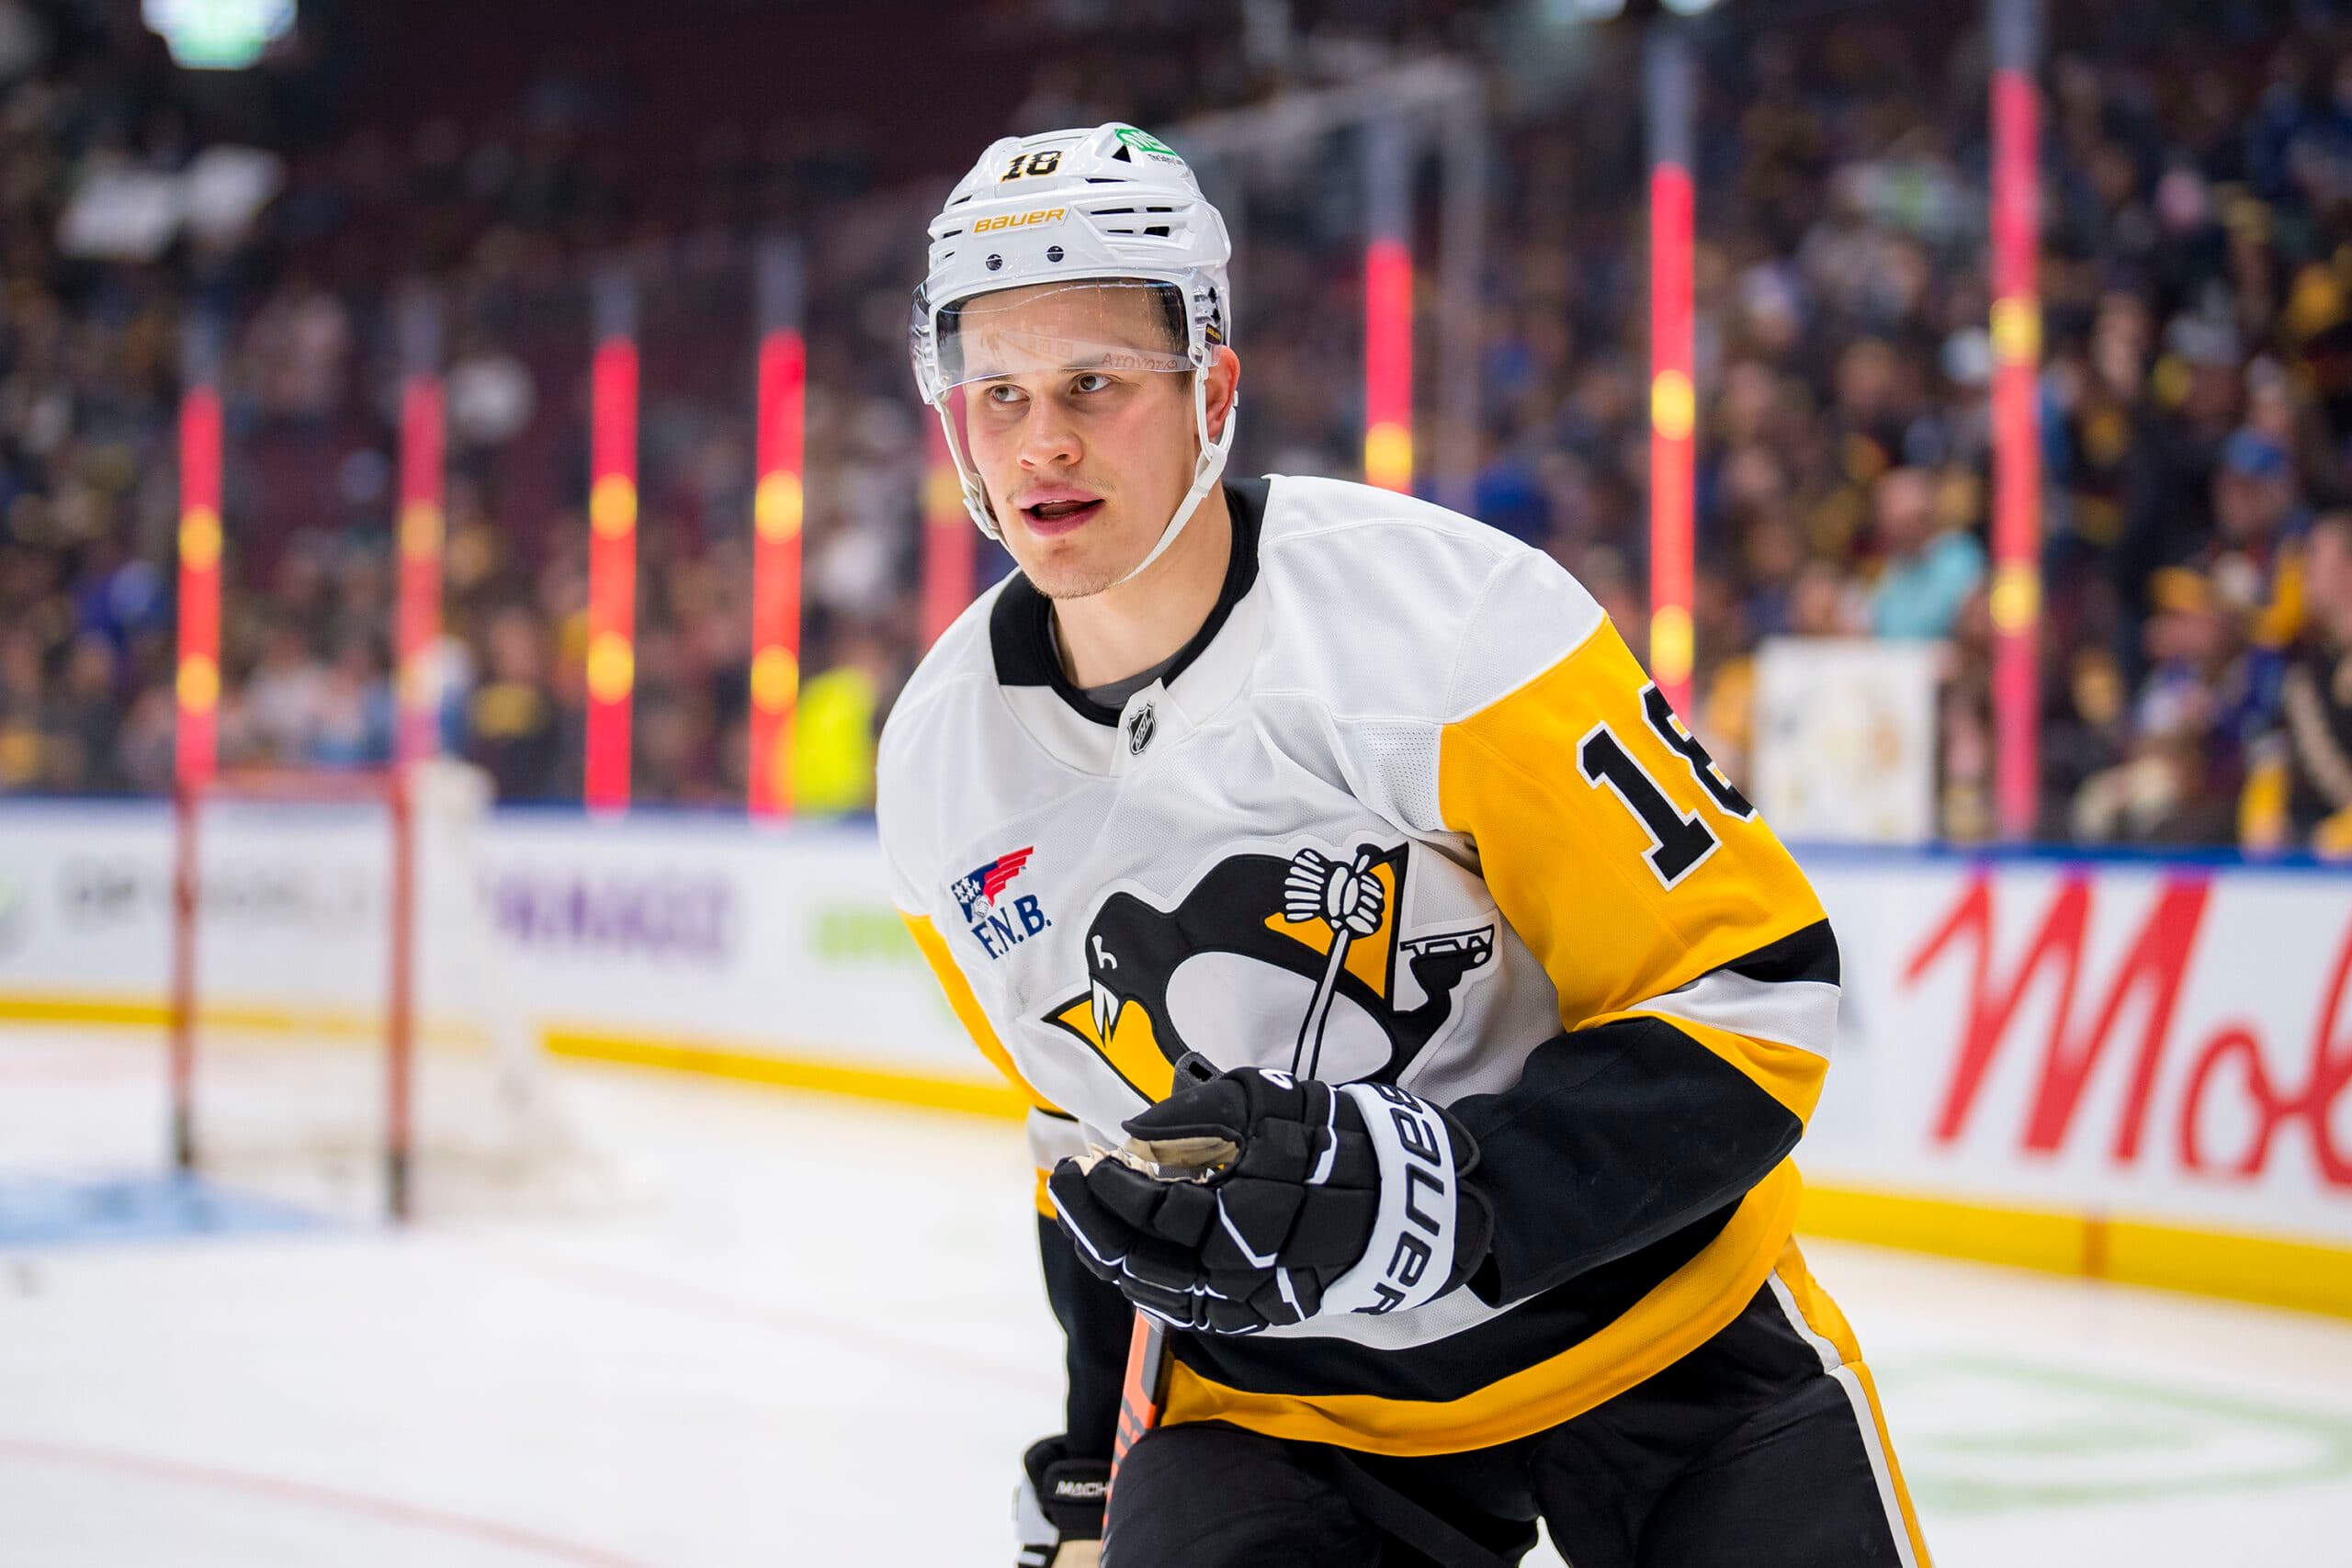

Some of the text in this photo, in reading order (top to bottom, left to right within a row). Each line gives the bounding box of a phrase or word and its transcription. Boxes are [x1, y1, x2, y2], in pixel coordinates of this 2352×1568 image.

[1001, 150, 1063, 183] 18
[974, 208, 1065, 233] BAUER
[971, 894, 1052, 960] F.N.B.
